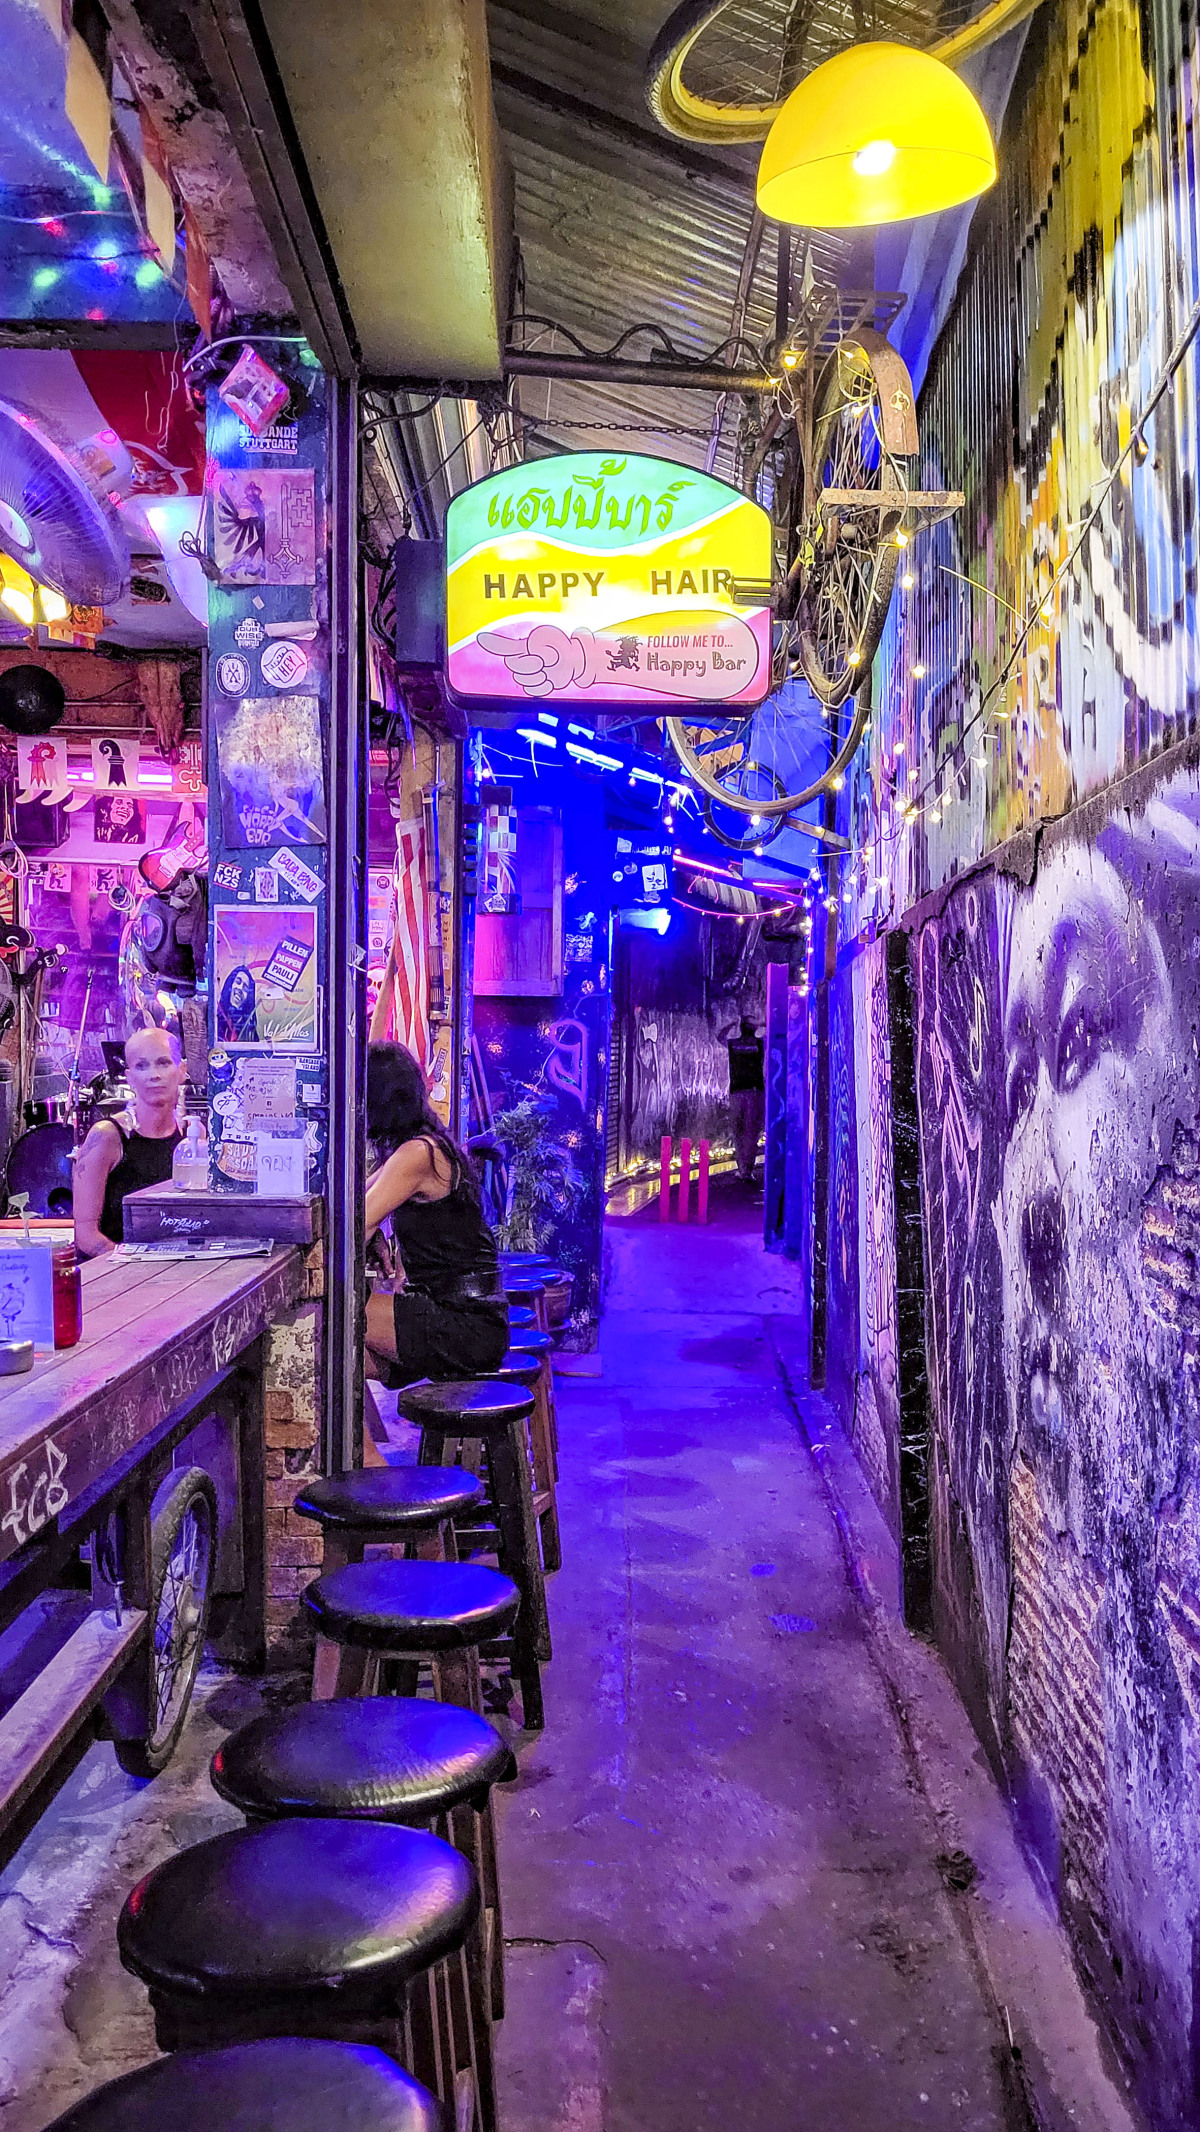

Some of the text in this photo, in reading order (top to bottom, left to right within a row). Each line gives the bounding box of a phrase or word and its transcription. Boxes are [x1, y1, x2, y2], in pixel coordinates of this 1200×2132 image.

[239, 437, 298, 450] STUTTGART
[488, 458, 697, 537] แฮปปี้บาร์
[484, 569, 731, 600] HAPPY HAIR
[647, 635, 733, 648] FOLLOW ME TO...
[278, 655, 297, 677] HEY
[646, 651, 747, 678] Happy Bar
[245, 828, 271, 846] BAR
[213, 872, 239, 888] NZS
[216, 863, 242, 880] FCK
[281, 940, 309, 958] PILLEN
[275, 953, 303, 969] PAPPEN
[271, 964, 295, 981] PAULI
[263, 1020, 280, 1037] Val
